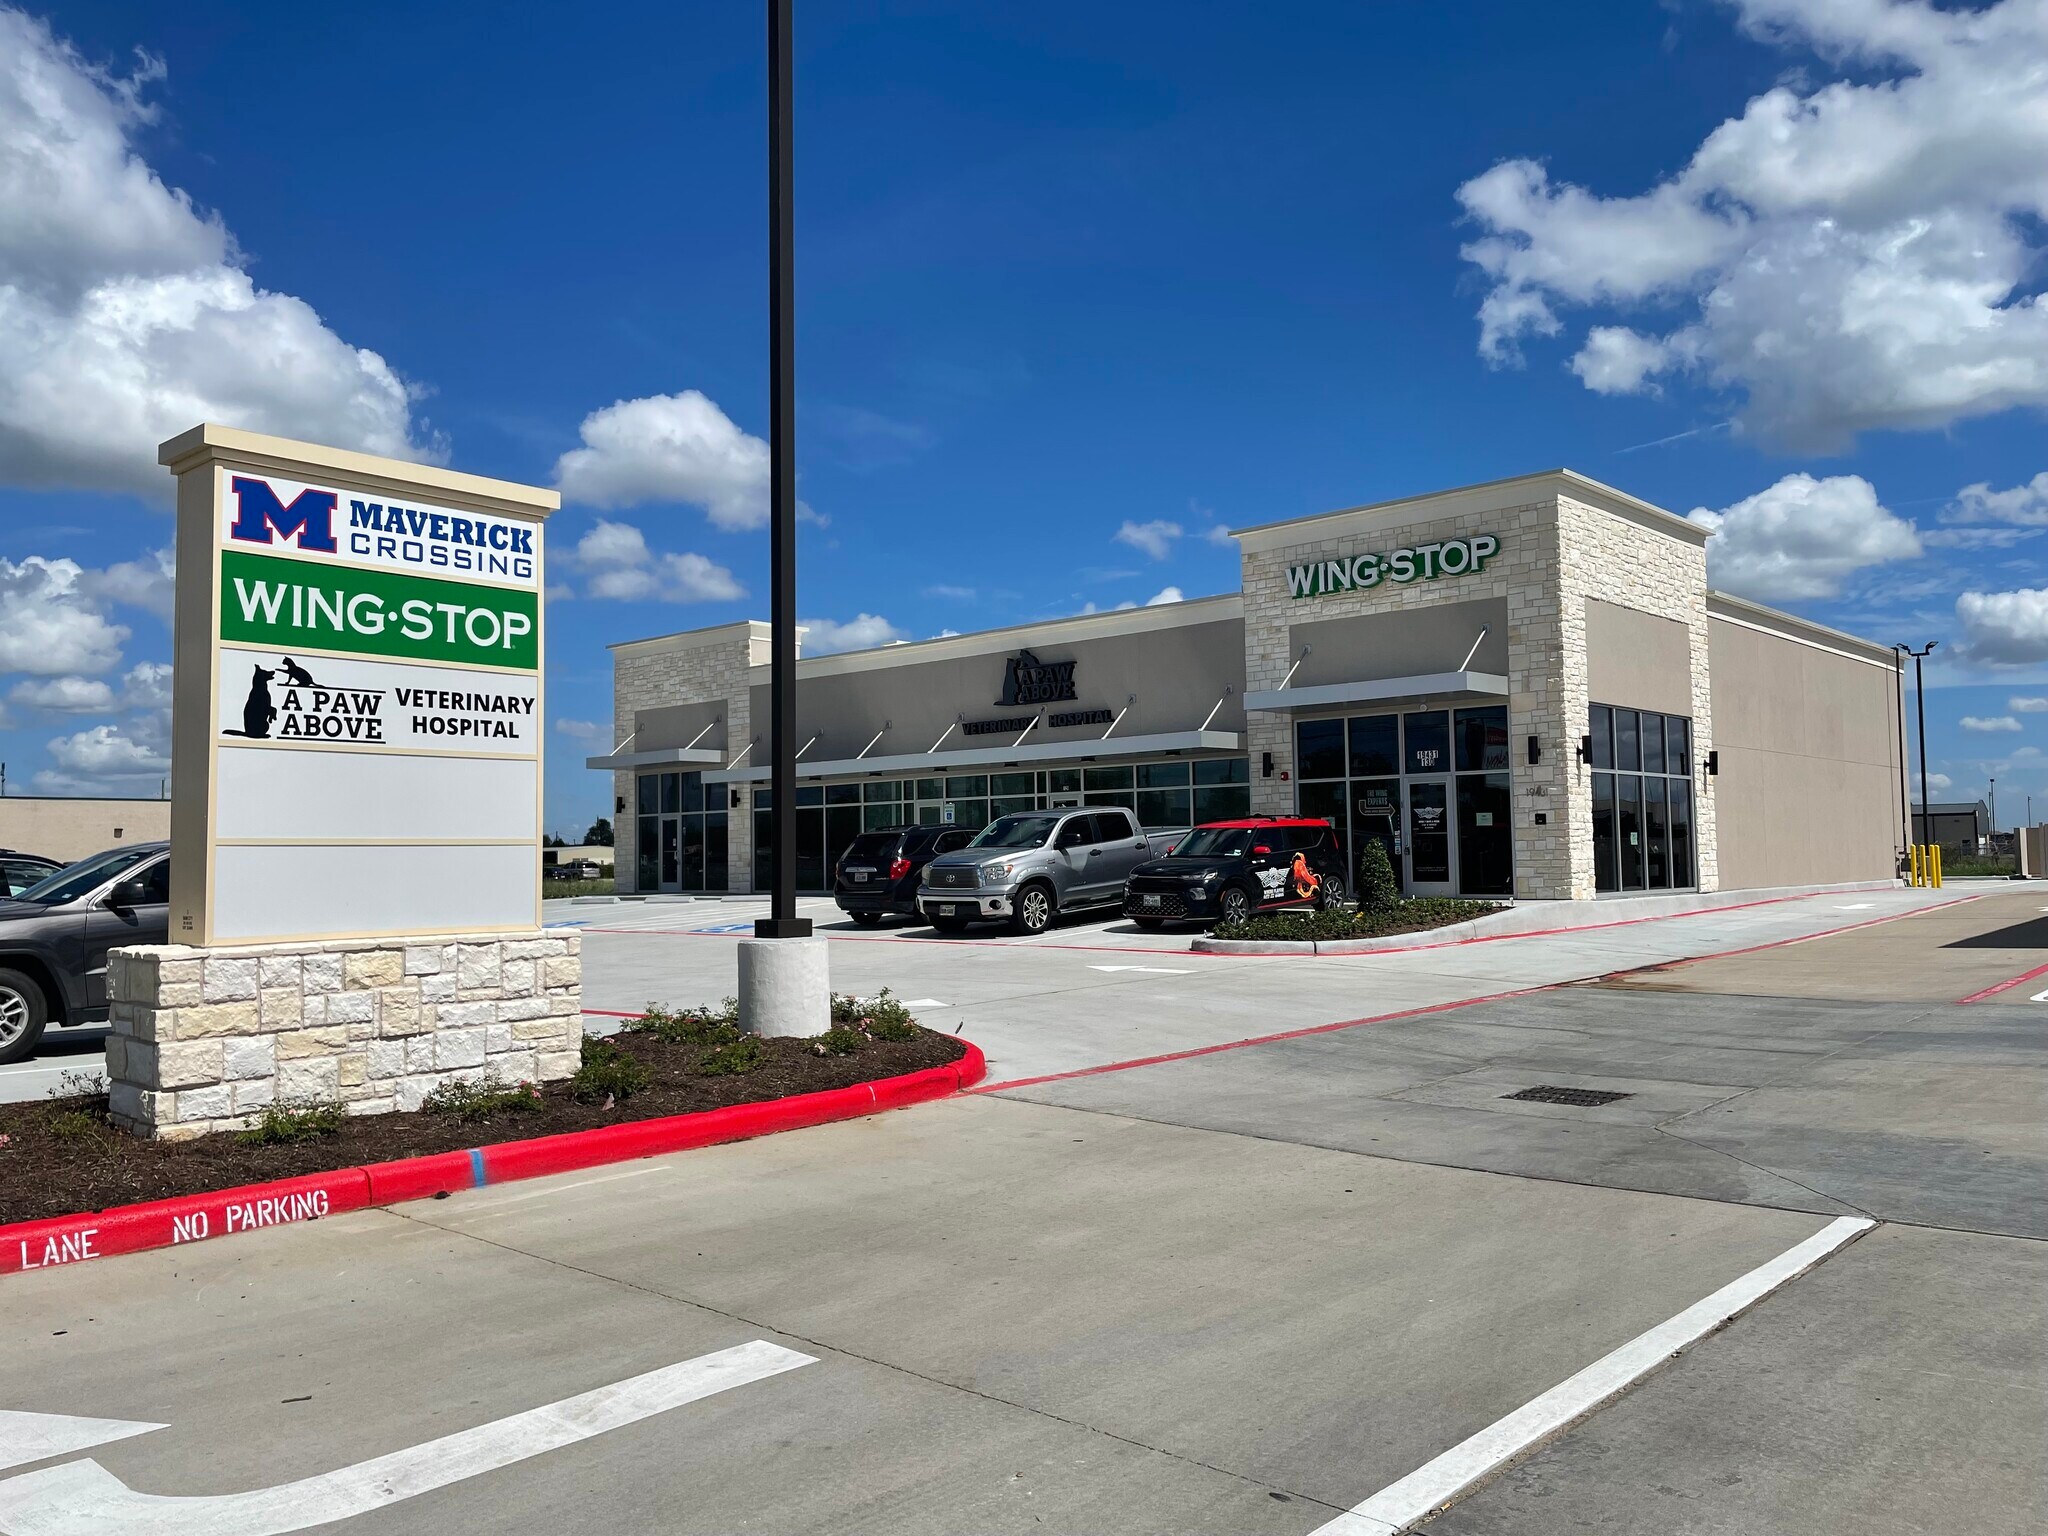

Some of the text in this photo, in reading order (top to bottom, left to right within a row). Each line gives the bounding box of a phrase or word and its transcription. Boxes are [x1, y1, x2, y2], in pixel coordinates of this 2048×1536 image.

[231, 475, 338, 554] M
[350, 499, 533, 555] MAVERICK
[350, 533, 532, 579] CROSSING
[1020, 665, 1073, 685] A PAW
[282, 689, 383, 716] A PAW
[395, 687, 535, 715] VETERINARY
[1021, 681, 1073, 701] ABOVE
[281, 714, 383, 740] ABOVE
[412, 716, 520, 739] HOSPITAL
[962, 710, 1112, 735] VETERINARY HOSPITAL
[173, 1190, 329, 1243] NO PARKING
[21, 1229, 100, 1270] LANE
